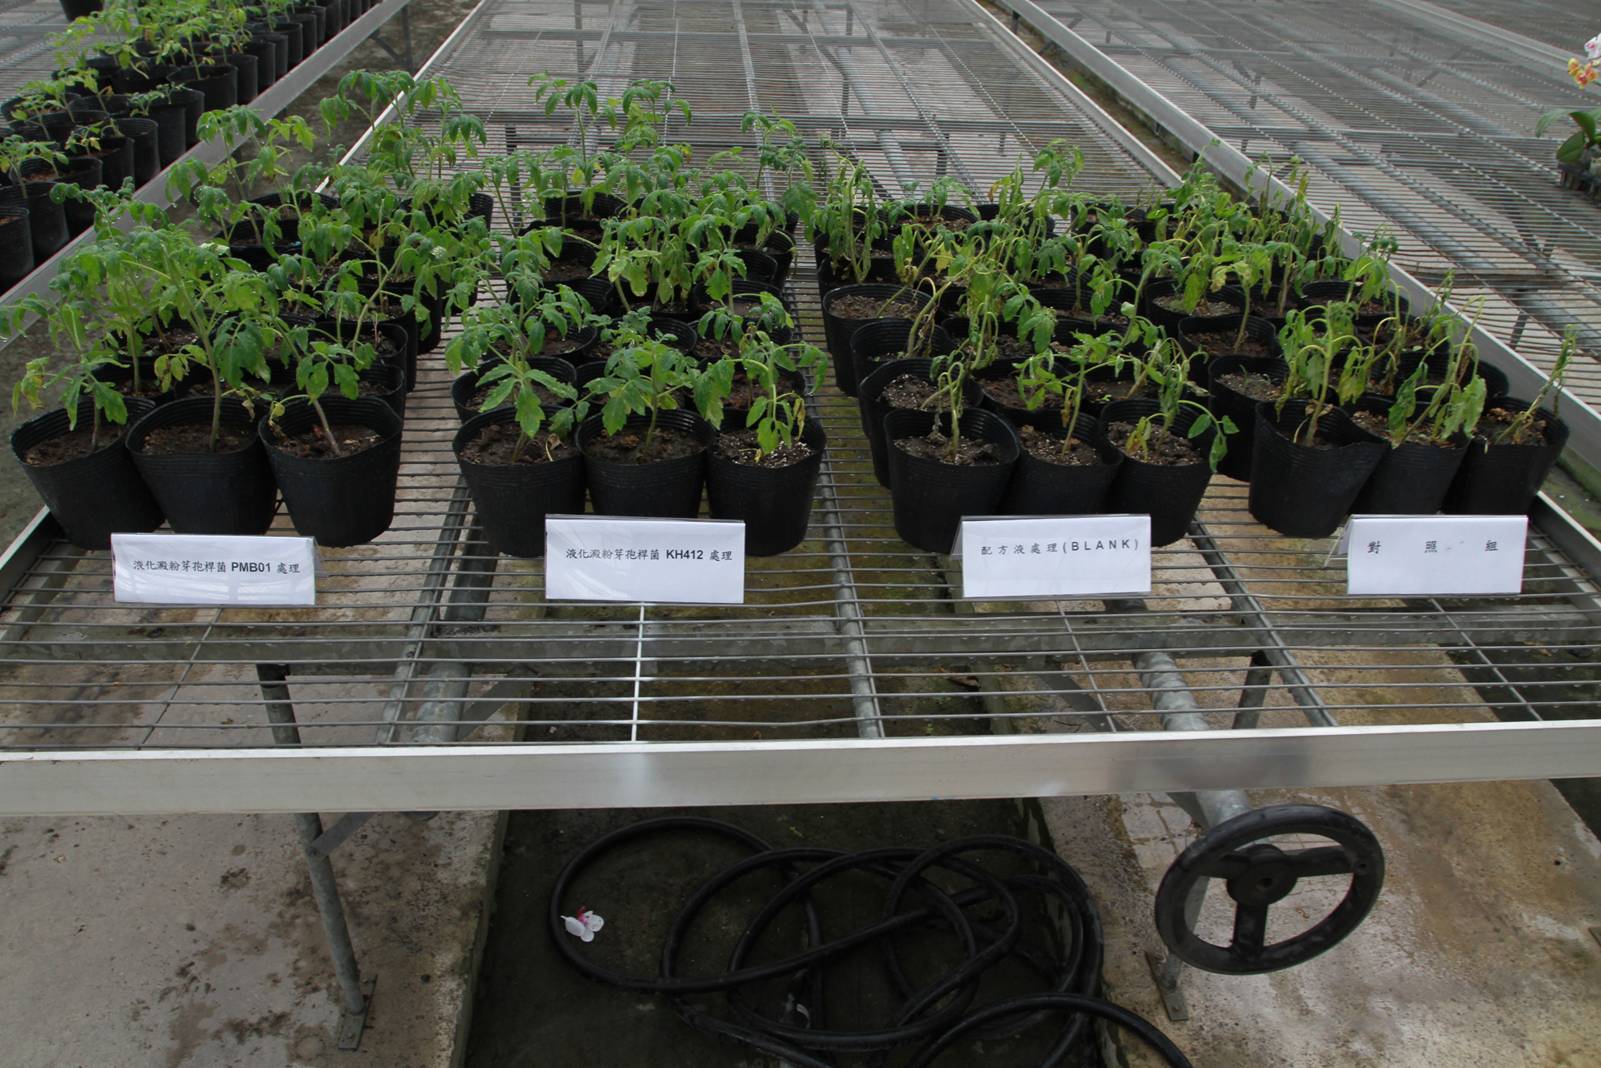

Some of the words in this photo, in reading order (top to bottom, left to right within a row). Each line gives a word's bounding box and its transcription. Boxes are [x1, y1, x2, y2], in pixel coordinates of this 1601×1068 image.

[666, 548, 704, 560] KH412
[709, 549, 733, 562] 處理
[231, 561, 271, 573] PMB01
[277, 561, 301, 575] 處理
